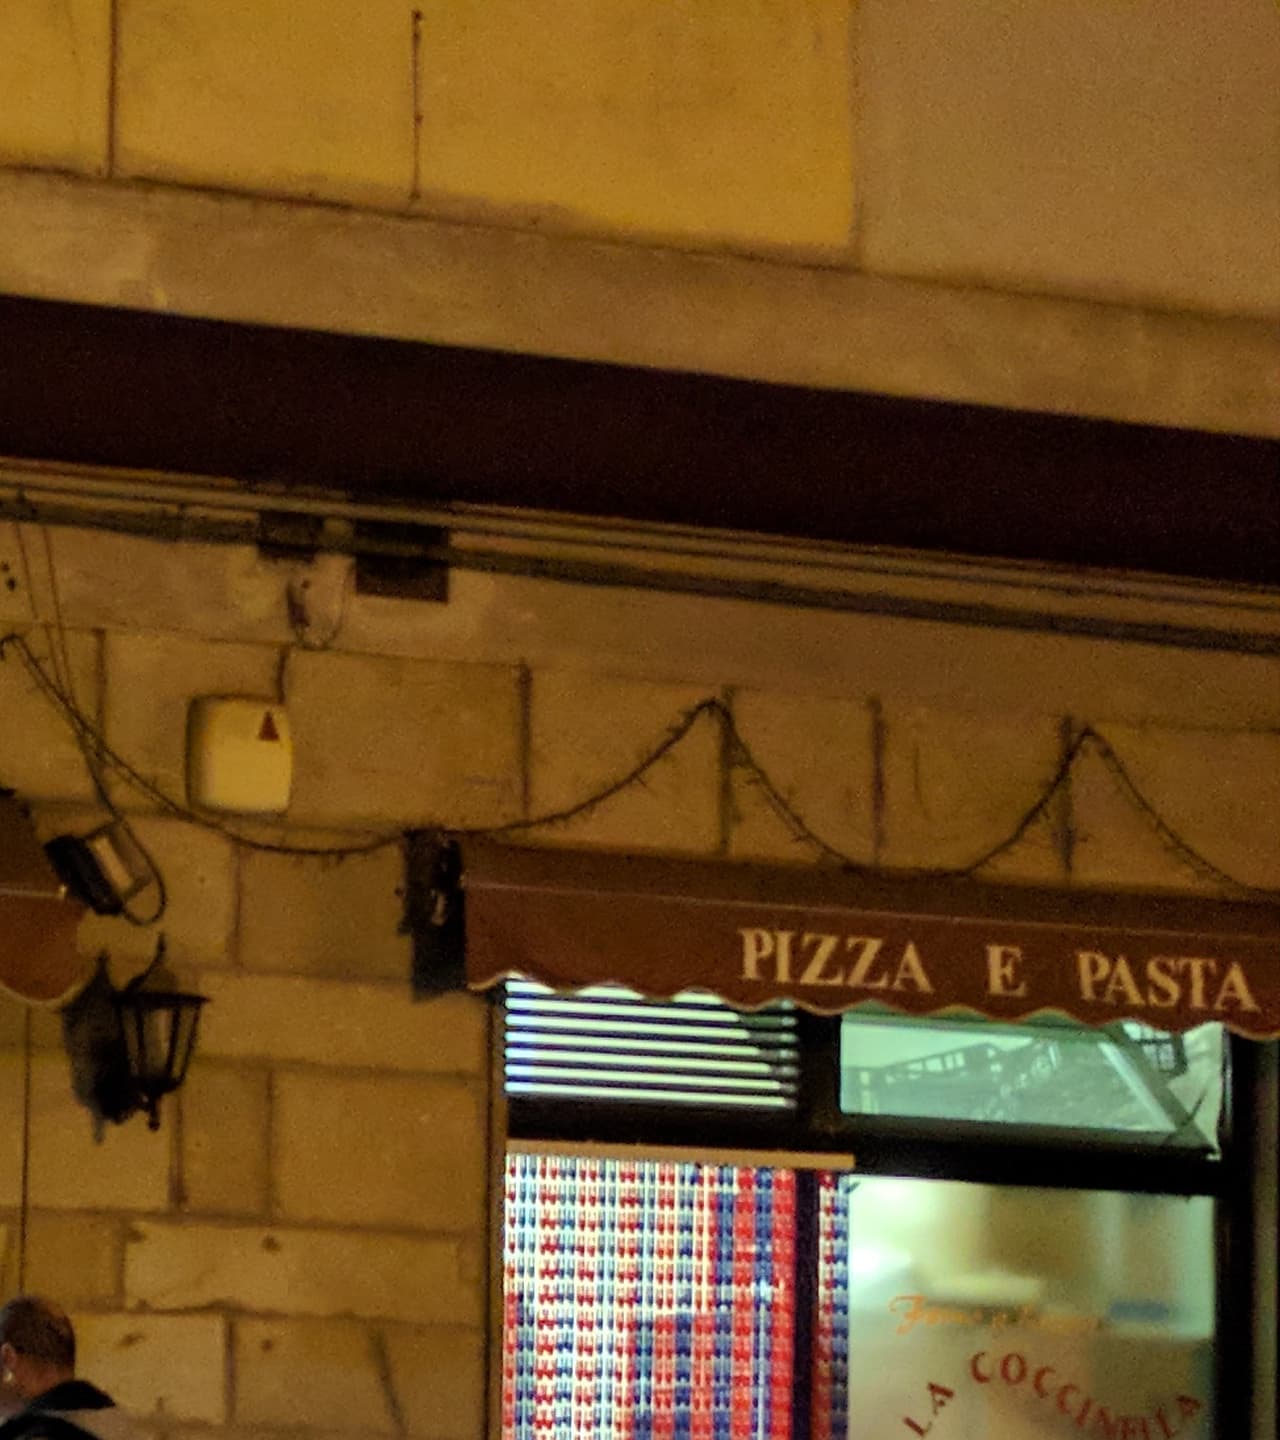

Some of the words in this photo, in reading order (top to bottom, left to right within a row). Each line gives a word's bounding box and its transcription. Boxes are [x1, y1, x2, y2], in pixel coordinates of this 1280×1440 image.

[741, 928, 934, 994] PIZZA
[986, 944, 1028, 998] E
[1077, 951, 1262, 1013] PASTA
[904, 1380, 955, 1439] LA
